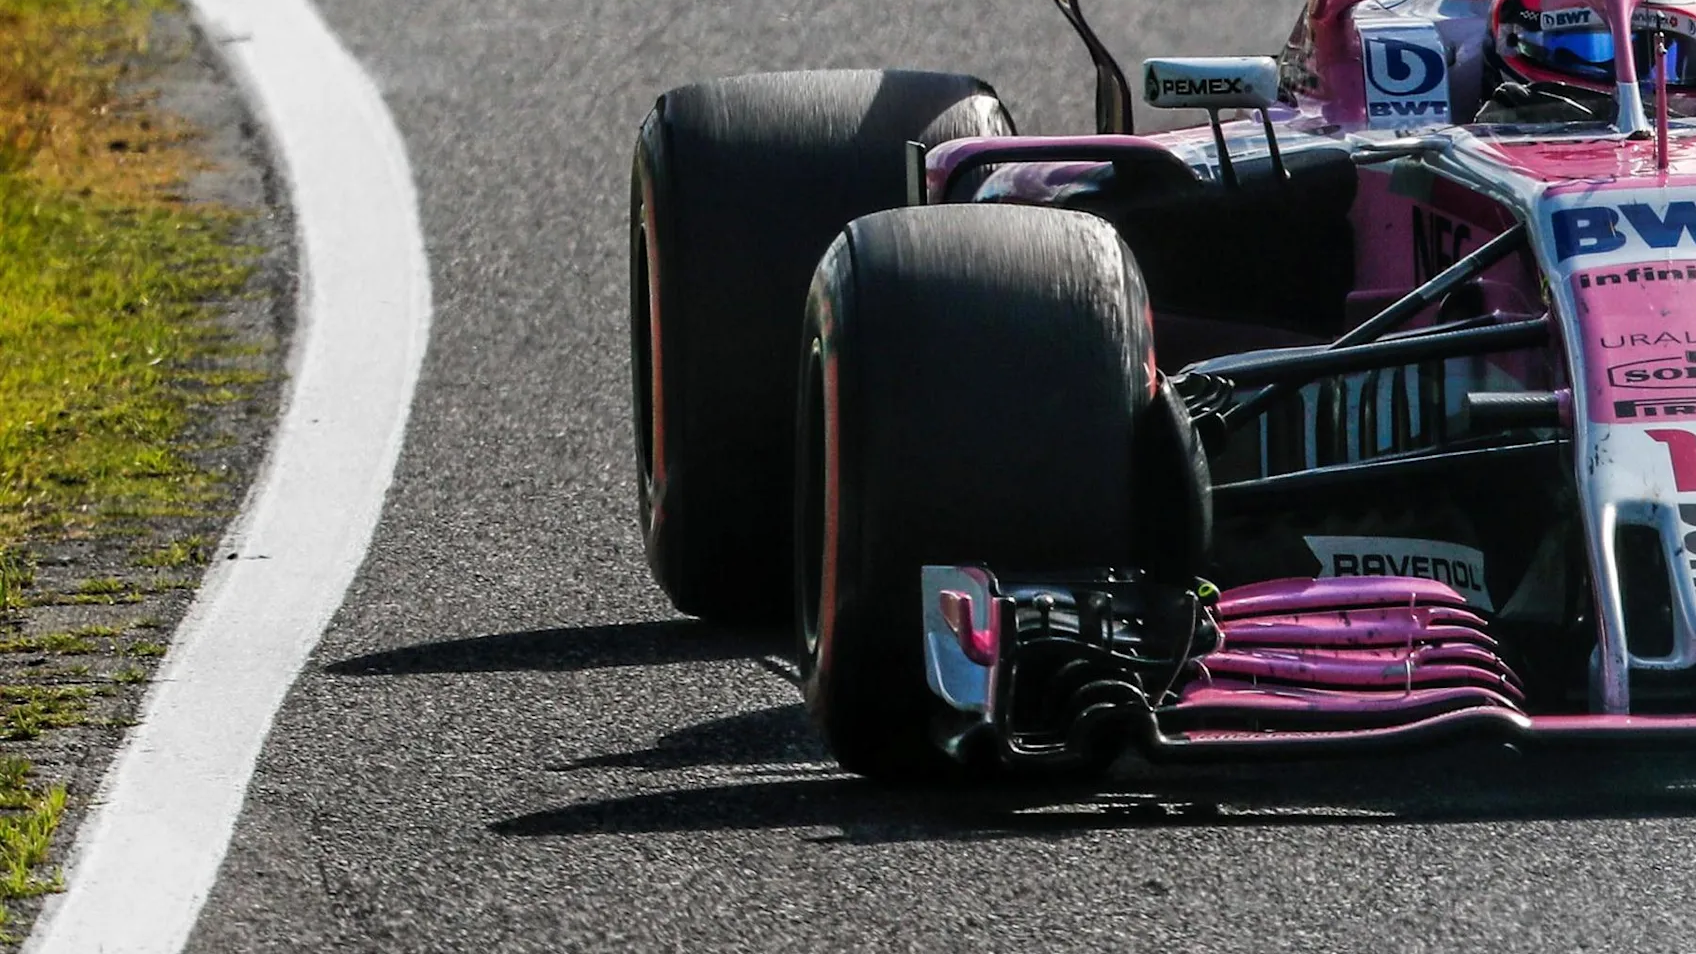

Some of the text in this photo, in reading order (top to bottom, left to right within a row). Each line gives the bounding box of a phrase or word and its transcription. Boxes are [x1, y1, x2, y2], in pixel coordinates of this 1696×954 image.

[1556, 10, 1591, 26] BWT
[1162, 77, 1242, 95] PEMEX
[1369, 100, 1448, 116] BWT
